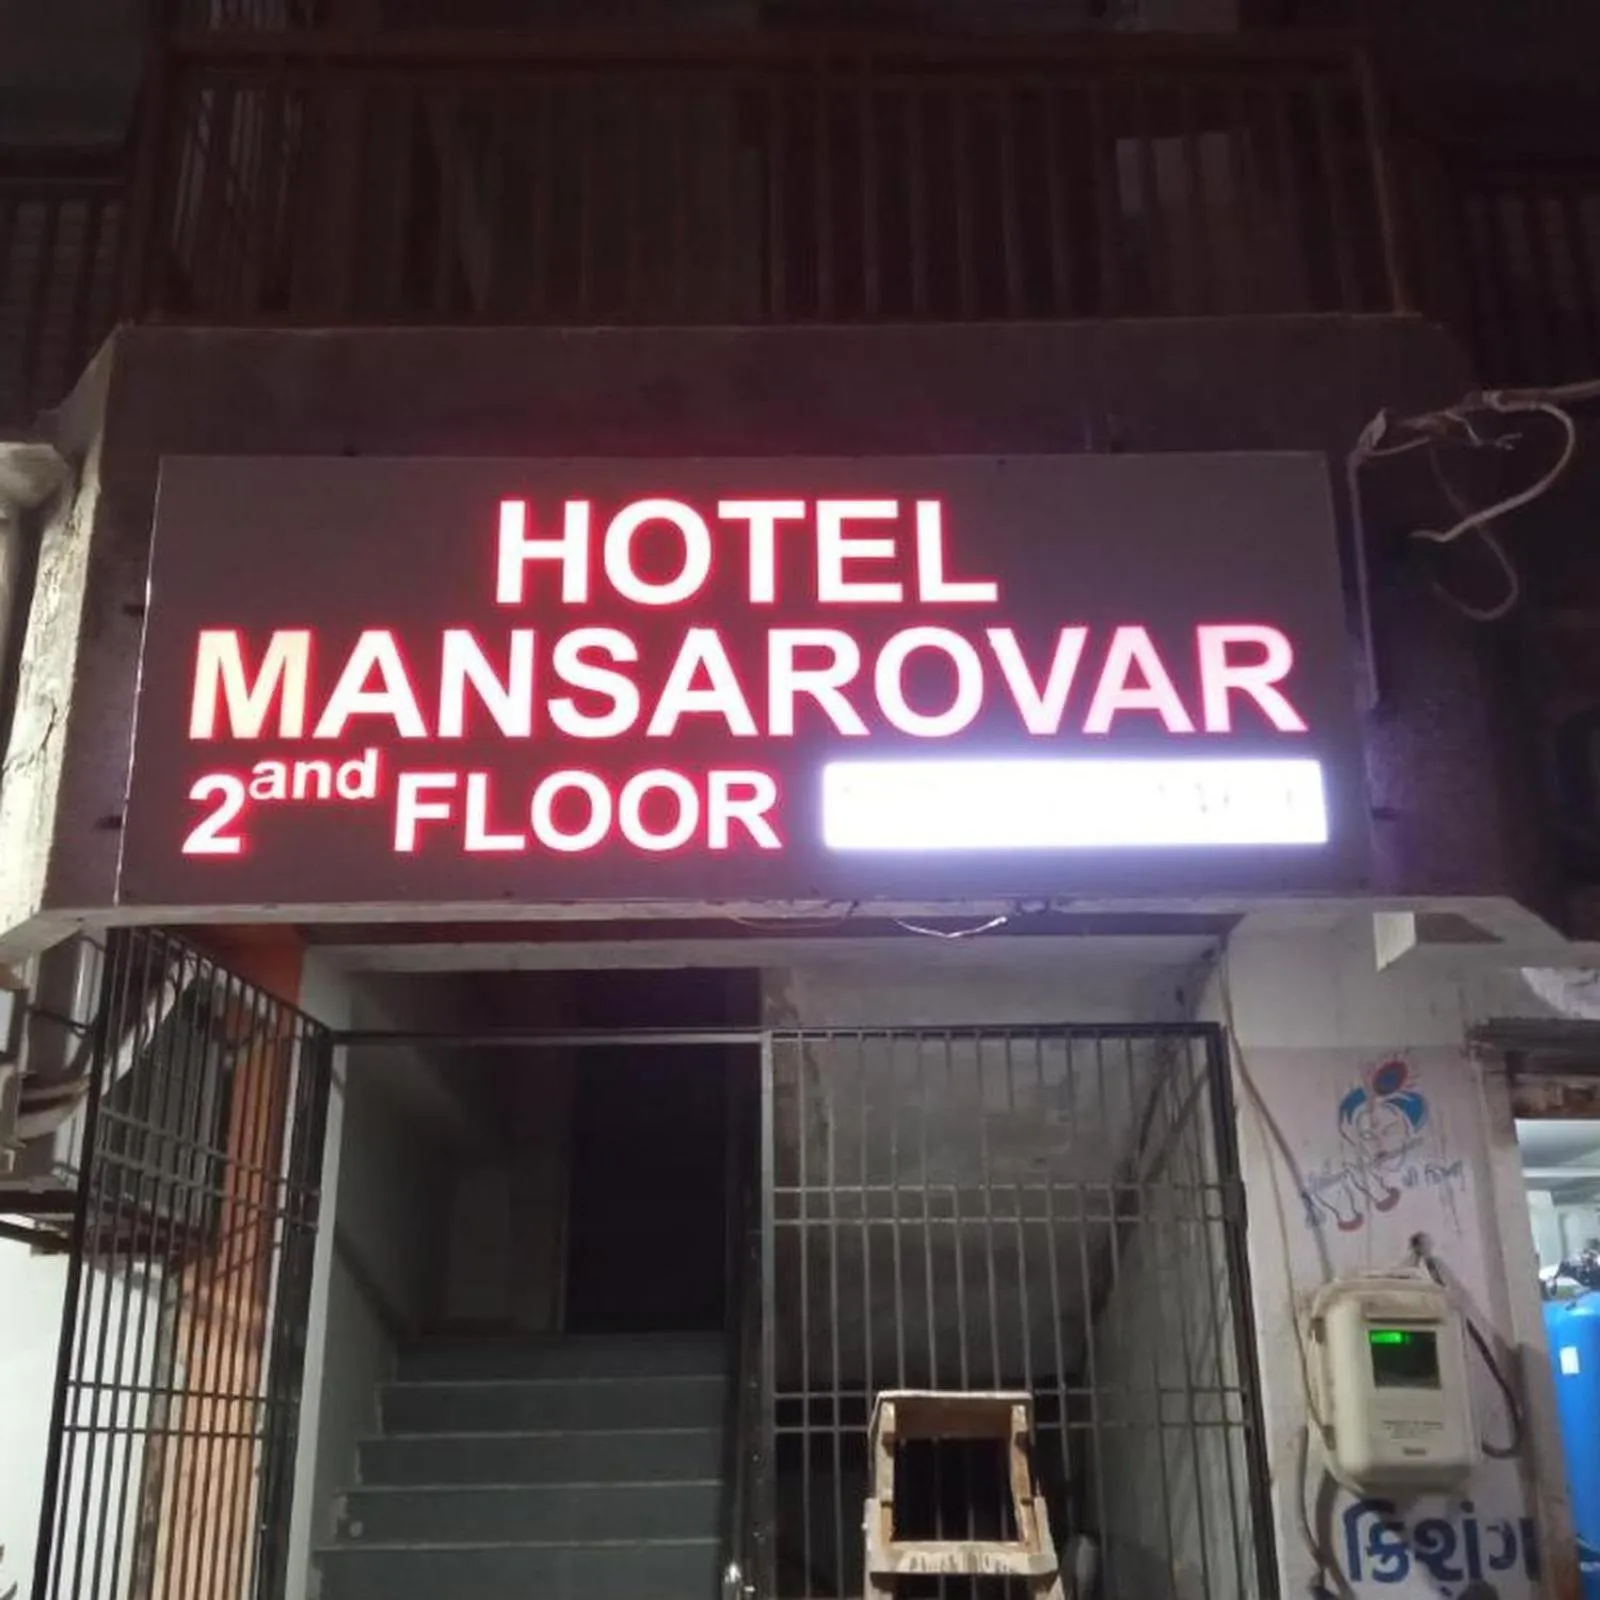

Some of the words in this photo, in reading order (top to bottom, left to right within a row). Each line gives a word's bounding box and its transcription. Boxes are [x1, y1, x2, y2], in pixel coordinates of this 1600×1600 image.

[496, 499, 998, 604] HOTEL
[188, 625, 1307, 739] MANSAROVAR
[394, 769, 783, 852] FLOOR
